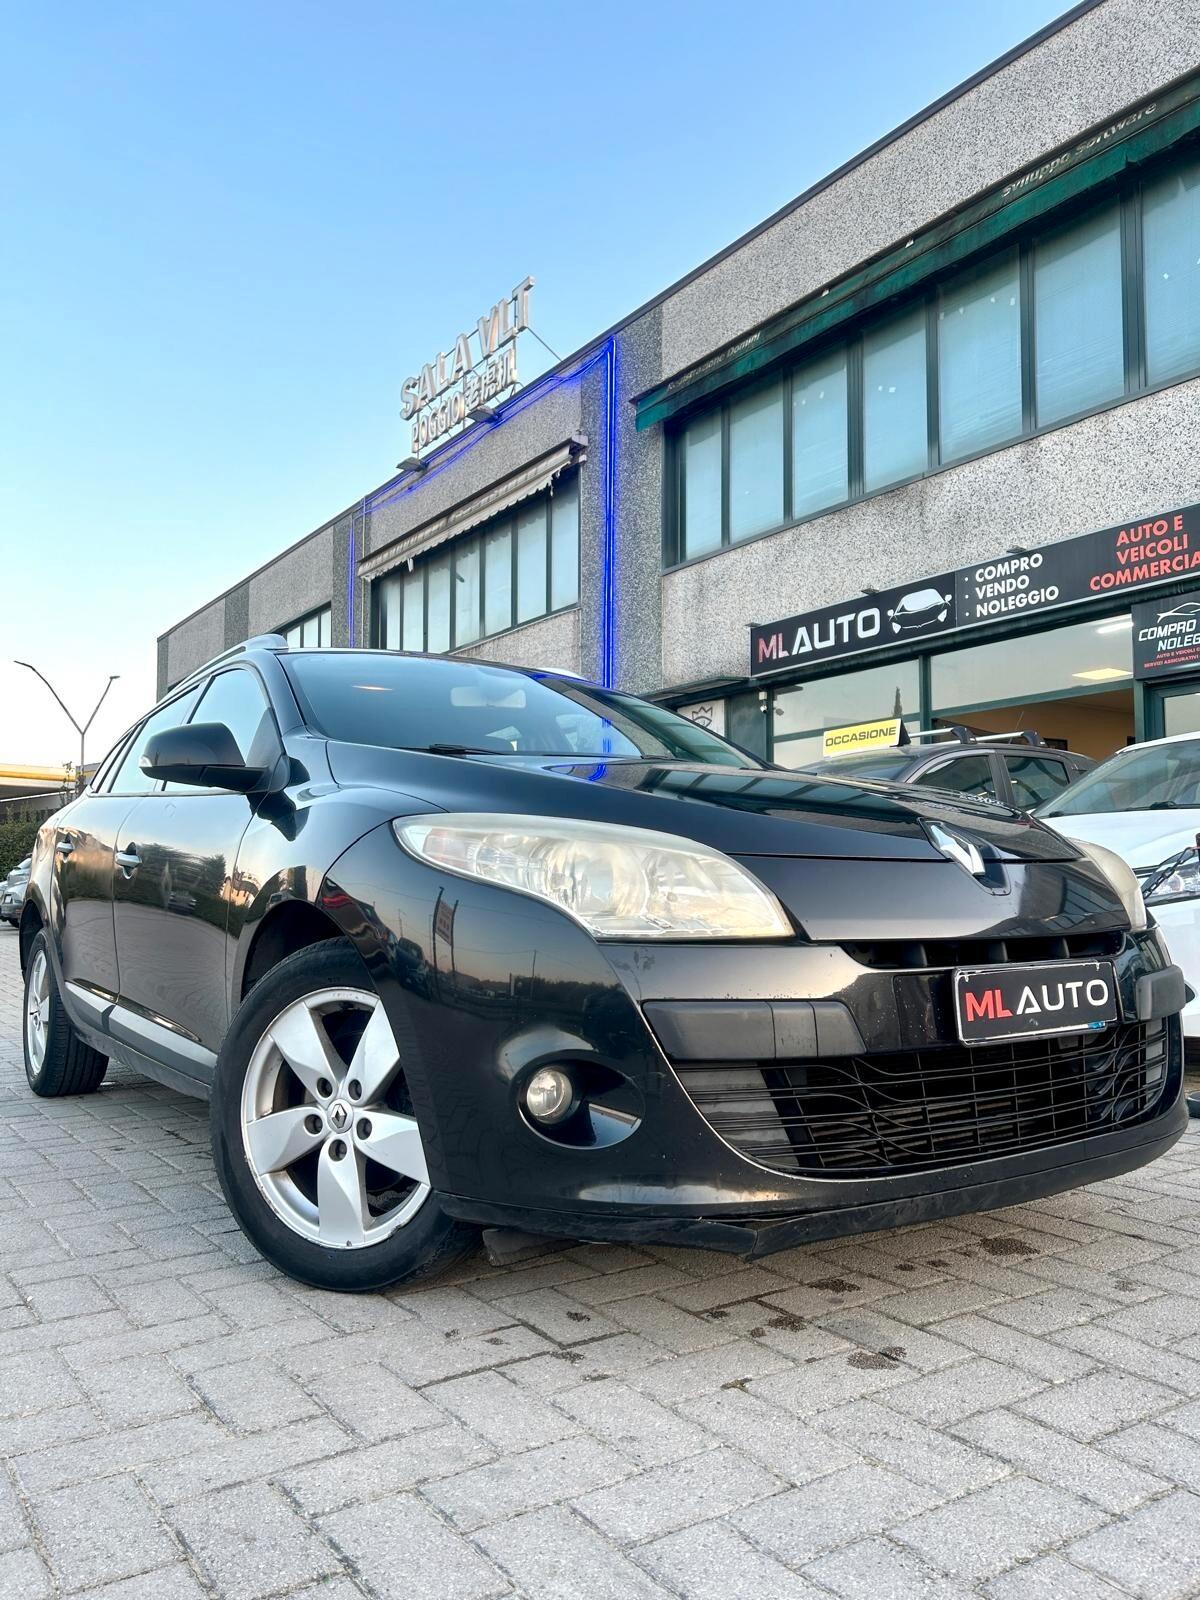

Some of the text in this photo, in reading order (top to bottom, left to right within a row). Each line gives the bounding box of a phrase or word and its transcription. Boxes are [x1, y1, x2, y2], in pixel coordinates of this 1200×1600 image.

[400, 275, 536, 421] SALA VLT
[411, 391, 465, 453] POGGIO
[1116, 514, 1184, 546] AUTO E
[1116, 533, 1188, 565] VEICOLI
[975, 553, 1043, 582] COMPRO
[975, 574, 1030, 600] VENDO
[976, 585, 1059, 618] NOLEGGIO
[1138, 619, 1197, 642] COMPRO
[825, 726, 897, 747] OCCASIONE
